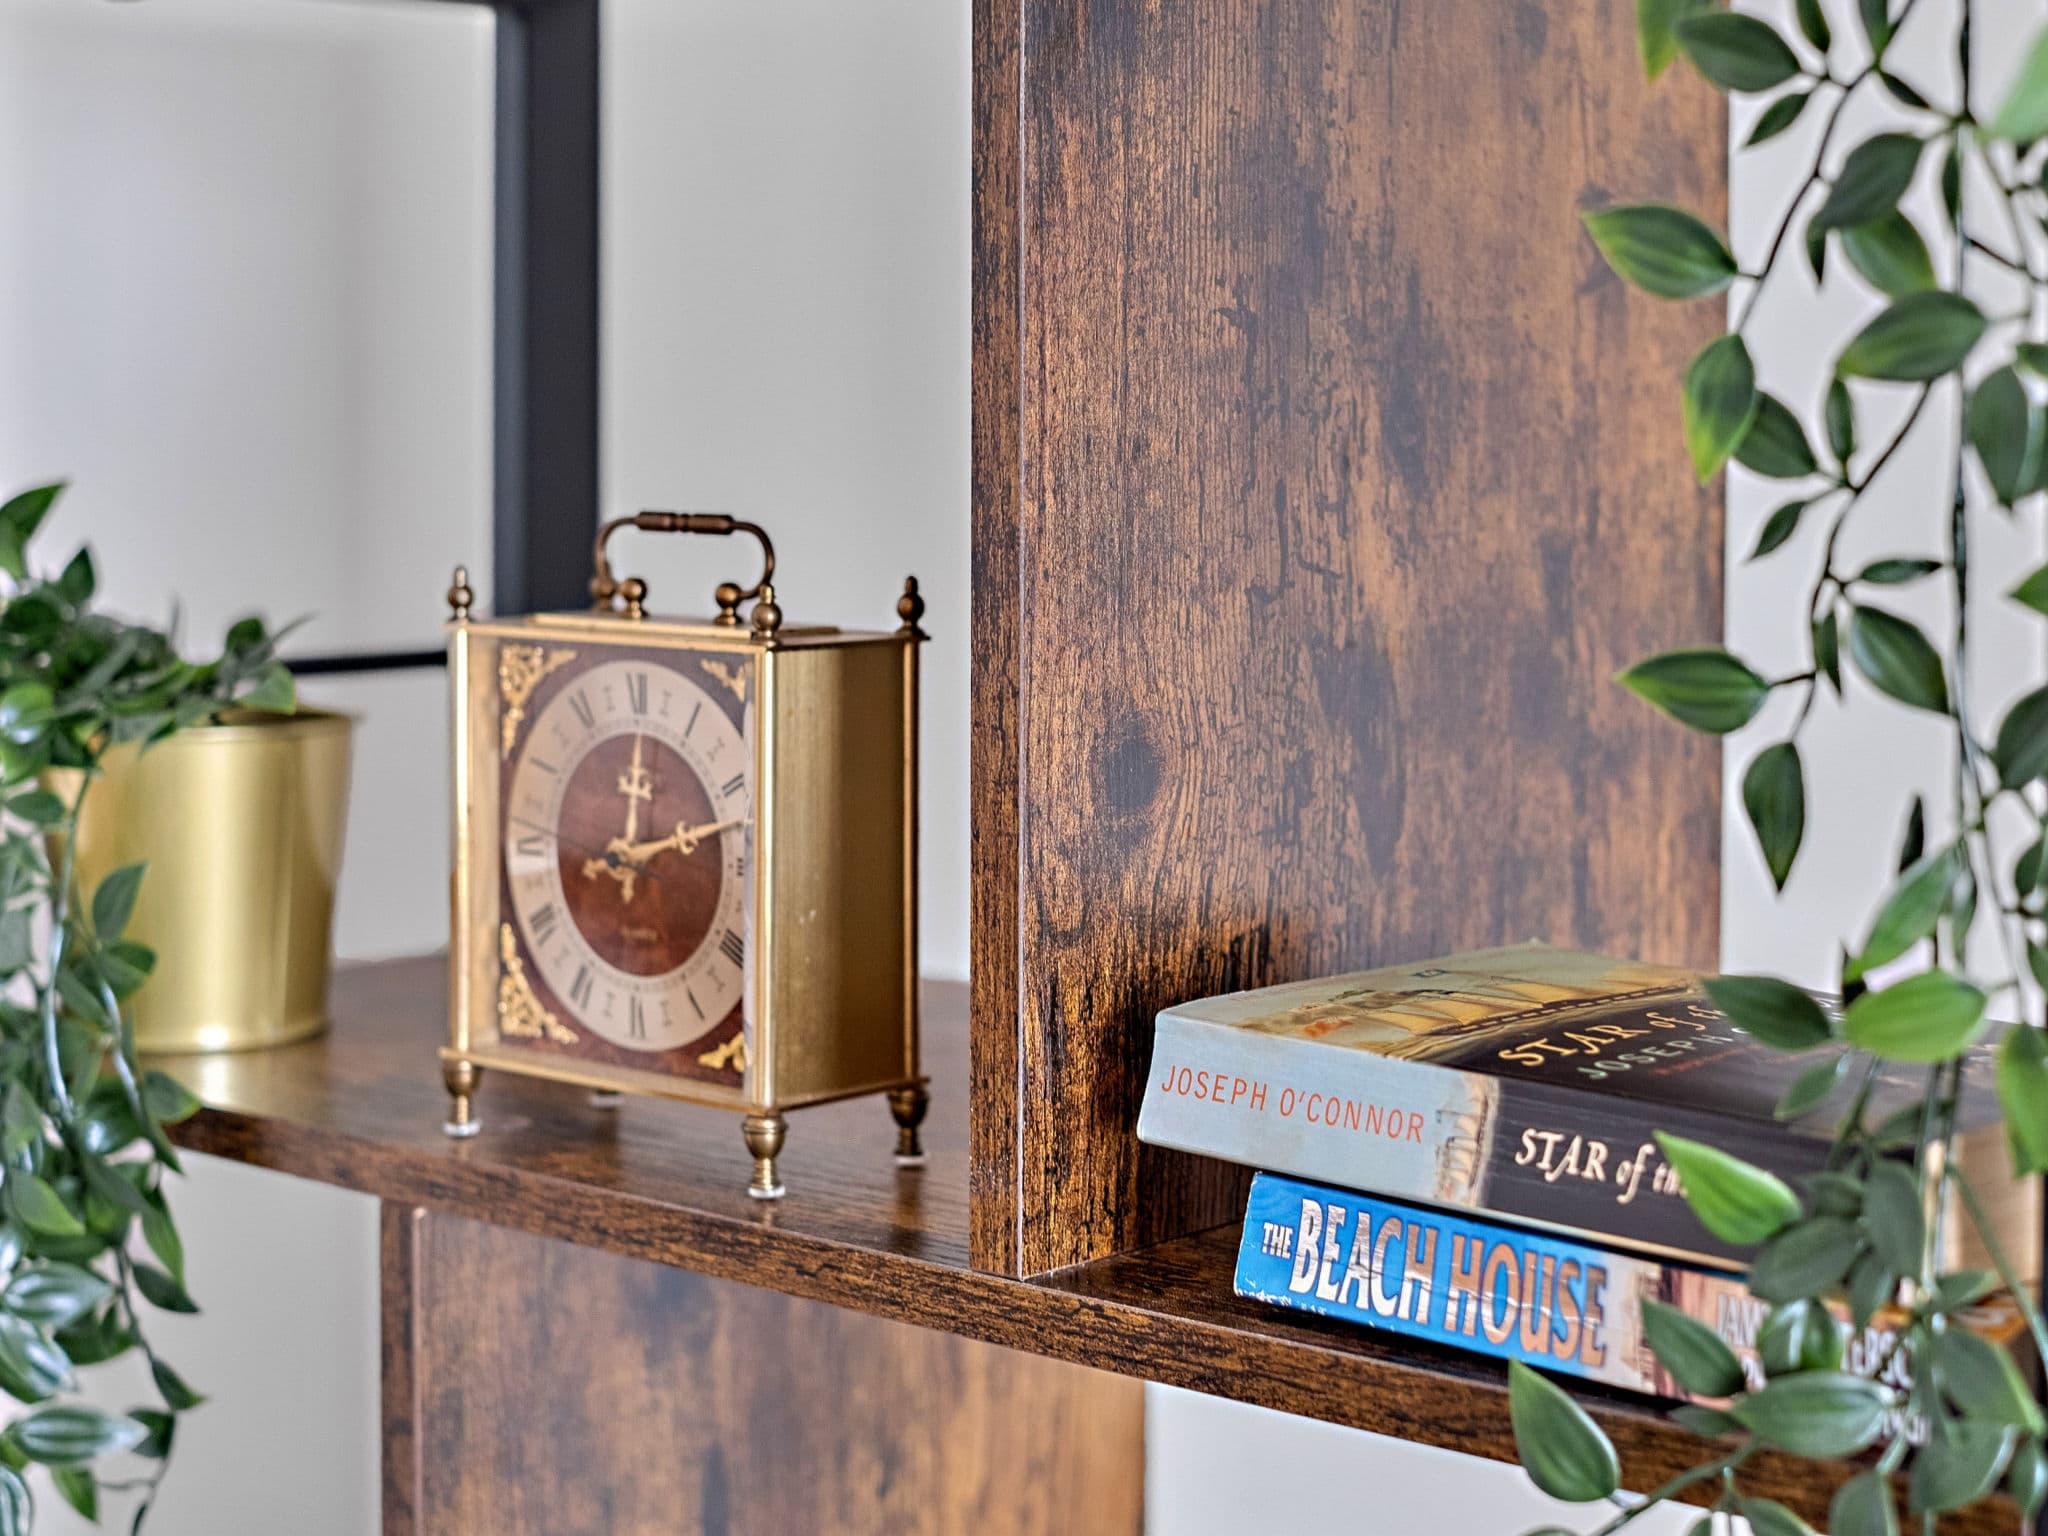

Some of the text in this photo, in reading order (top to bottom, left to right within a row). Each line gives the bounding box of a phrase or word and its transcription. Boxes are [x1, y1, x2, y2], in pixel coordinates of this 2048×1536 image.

[1497, 1024, 1652, 1068] STAR
[1645, 1011, 1707, 1031] of
[1576, 1033, 1735, 1081] JOSEPH
[1161, 1064, 1425, 1144] JOSEPH O'CONNOR
[1514, 1128, 1689, 1206] STAR of th
[1261, 1221, 1294, 1260] THE
[1287, 1197, 1439, 1326] BEACH
[1443, 1233, 1608, 1367] HOUSE
